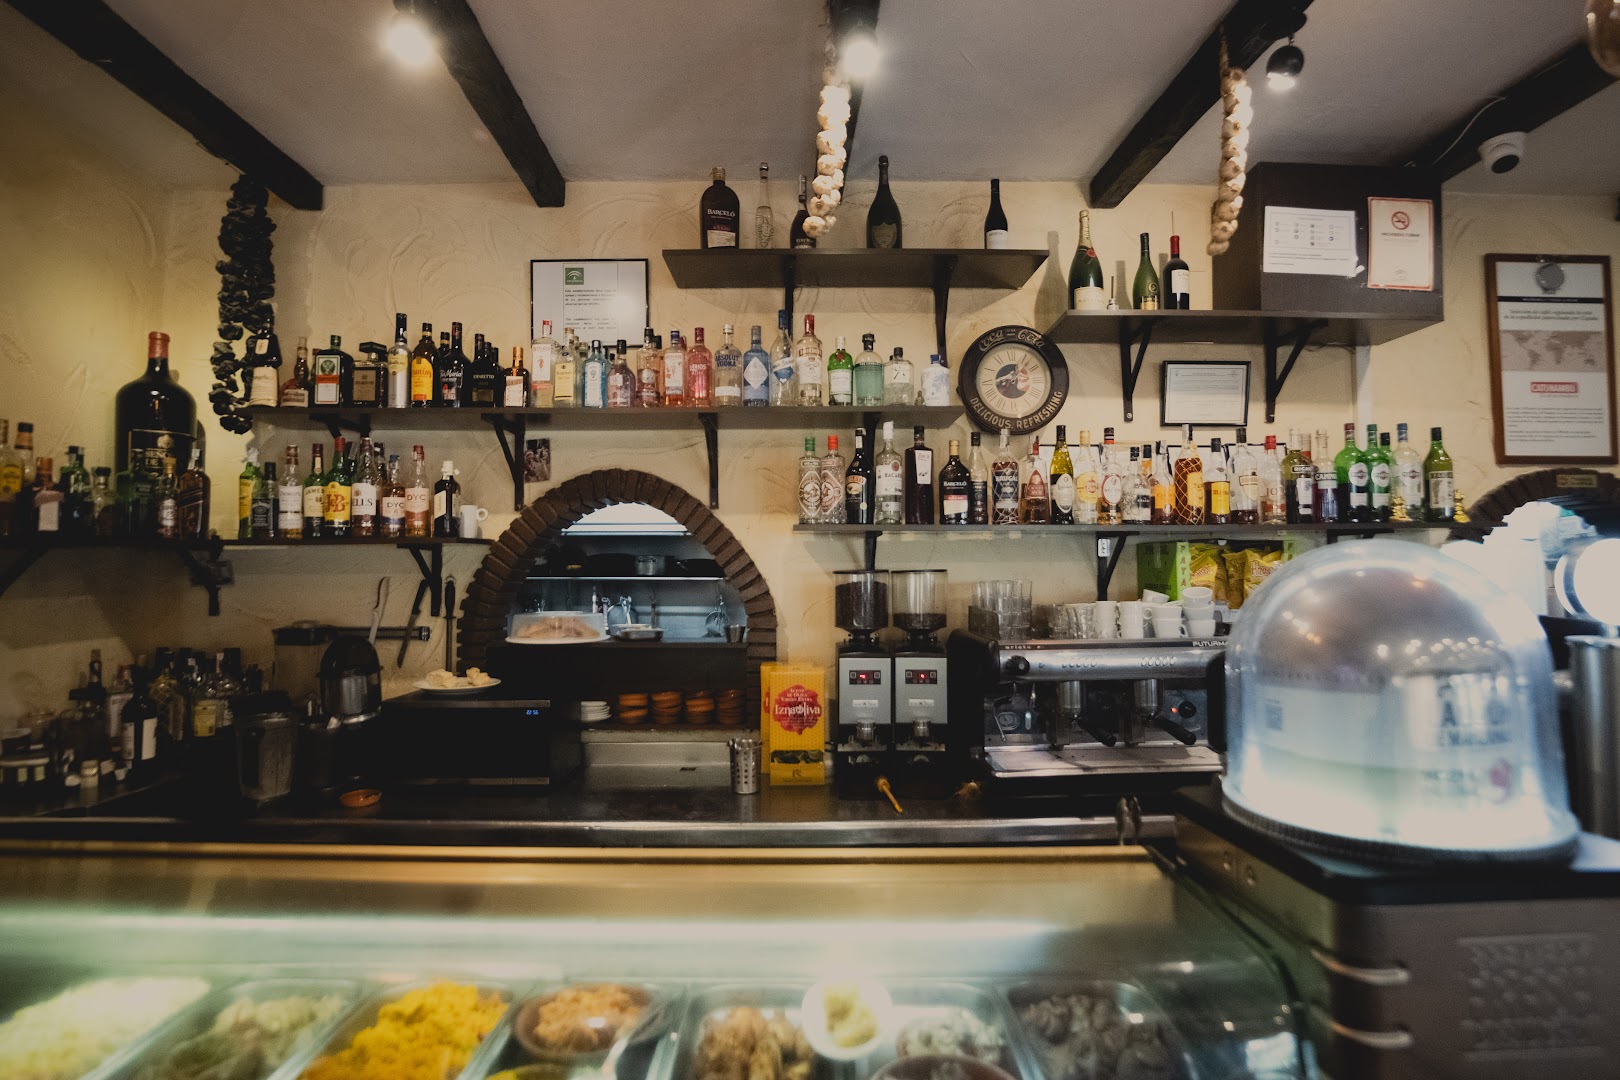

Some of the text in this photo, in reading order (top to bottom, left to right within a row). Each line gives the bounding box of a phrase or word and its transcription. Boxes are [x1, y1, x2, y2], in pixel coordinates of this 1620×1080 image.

[707, 208, 736, 217] BARCELÓ
[716, 353, 739, 362] ABSOLUT
[717, 359, 736, 368] VODKA
[1016, 391, 1062, 430] REFRESHING
